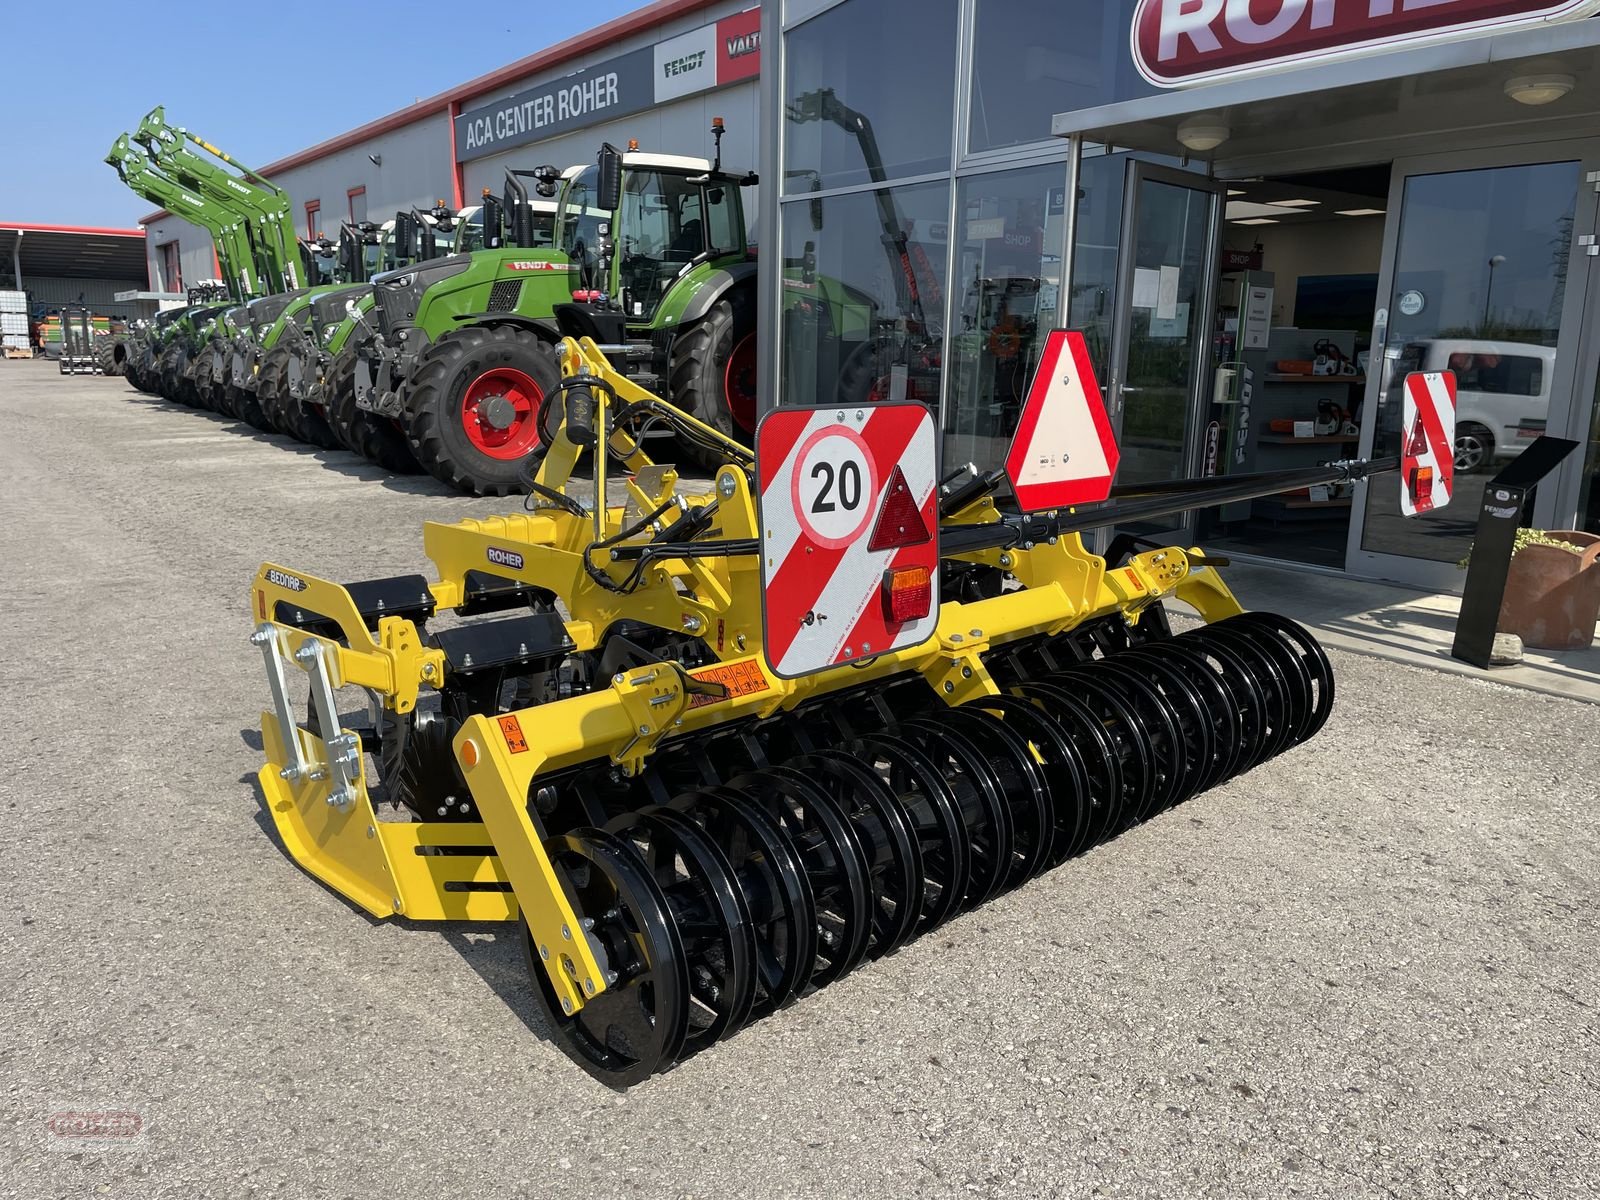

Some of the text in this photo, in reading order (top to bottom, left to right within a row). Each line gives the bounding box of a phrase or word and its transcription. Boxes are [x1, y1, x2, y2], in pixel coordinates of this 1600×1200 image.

[726, 31, 761, 59] VALT
[664, 50, 706, 78] FENDT
[466, 72, 618, 150] ACA CENTER ROHER
[227, 179, 252, 195] FENDT
[1005, 233, 1031, 246] SHOP
[513, 261, 548, 270] FENDT
[1230, 254, 1249, 265] SHOP
[1205, 426, 1218, 478] ROH
[811, 460, 861, 513] 20
[488, 549, 522, 568] ROHER
[270, 569, 300, 591] BEDNAR
